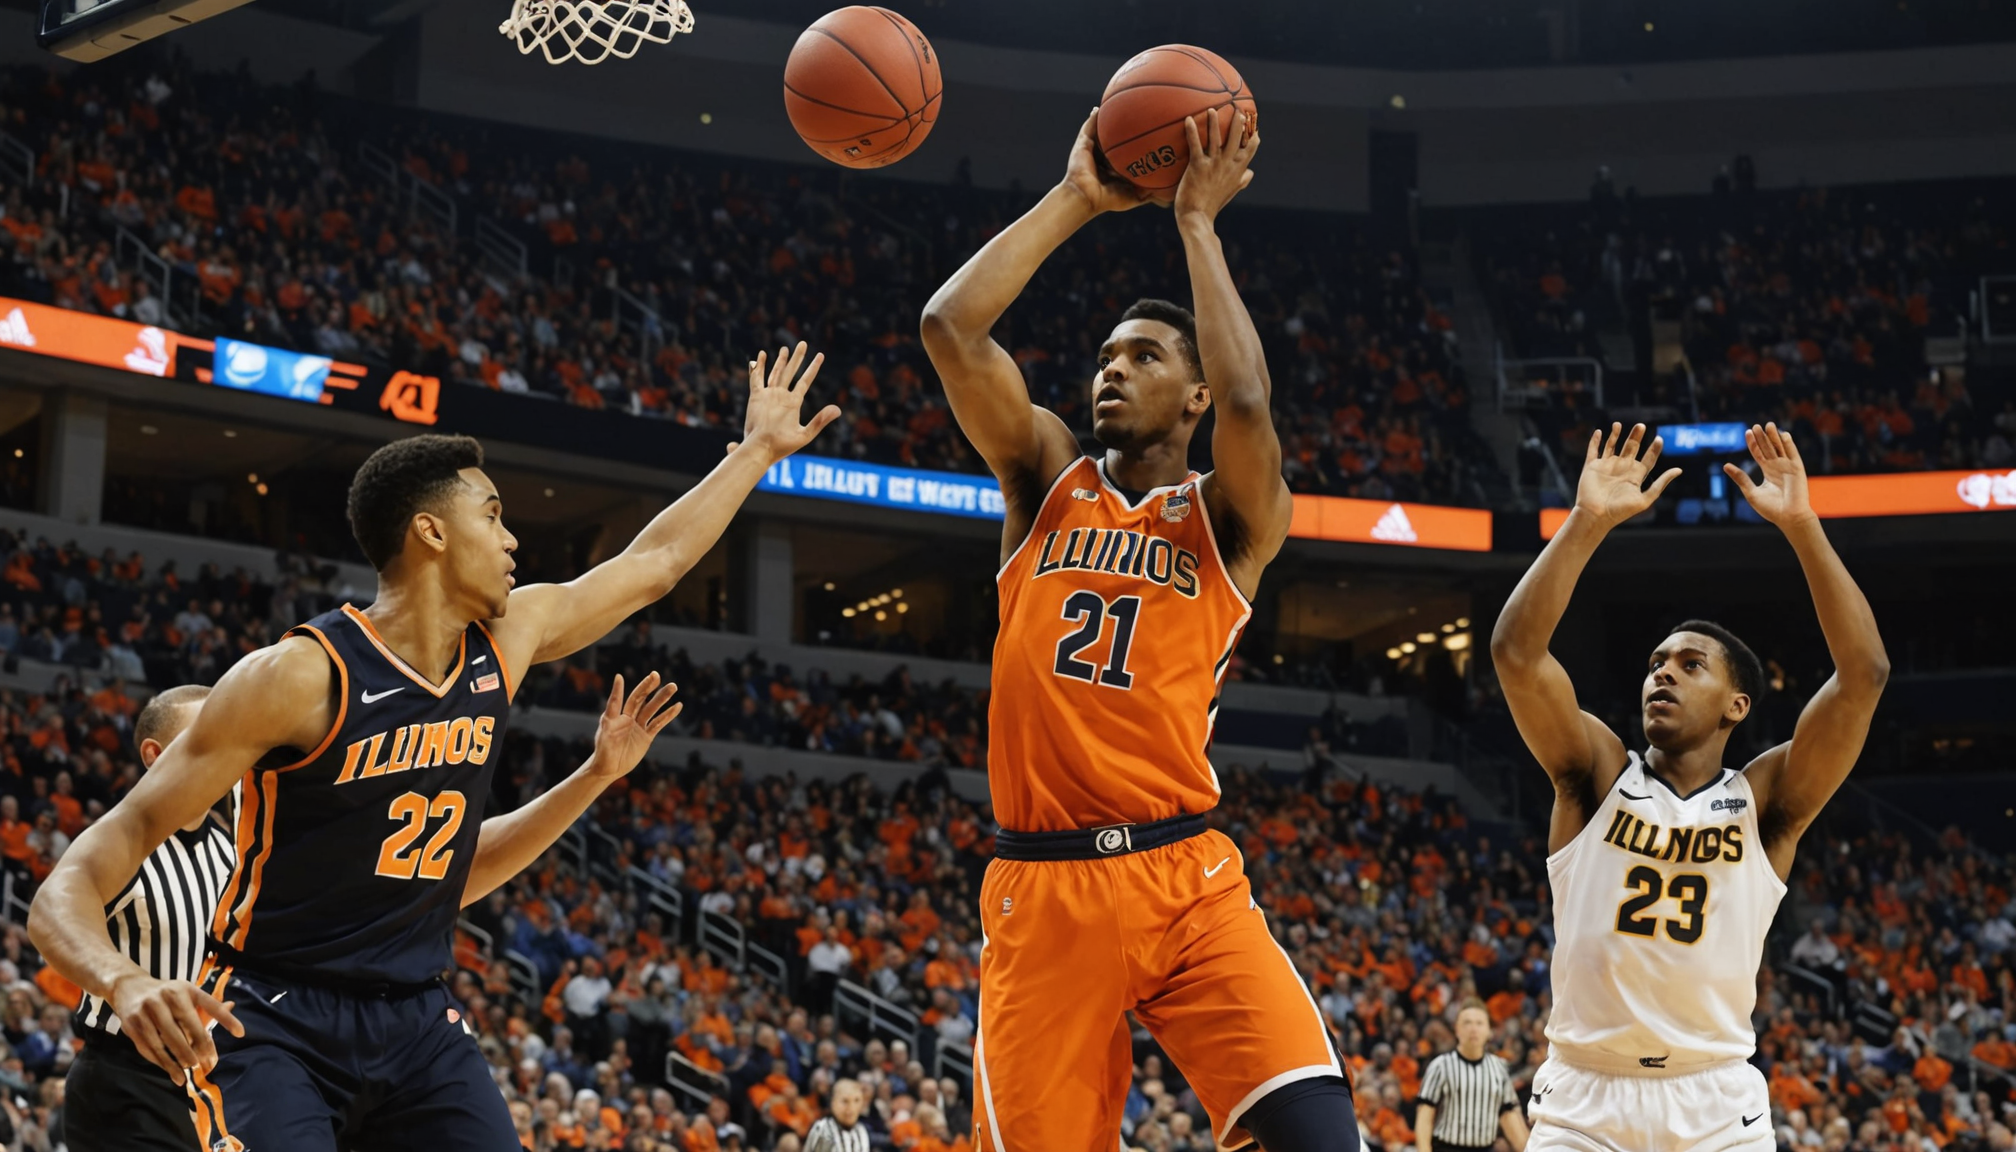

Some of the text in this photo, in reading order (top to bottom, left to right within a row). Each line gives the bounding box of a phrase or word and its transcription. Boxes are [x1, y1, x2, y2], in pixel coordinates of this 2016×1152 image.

[1053, 589, 1142, 691] 21
[374, 790, 467, 880] 22
[1614, 864, 1710, 946] 23
